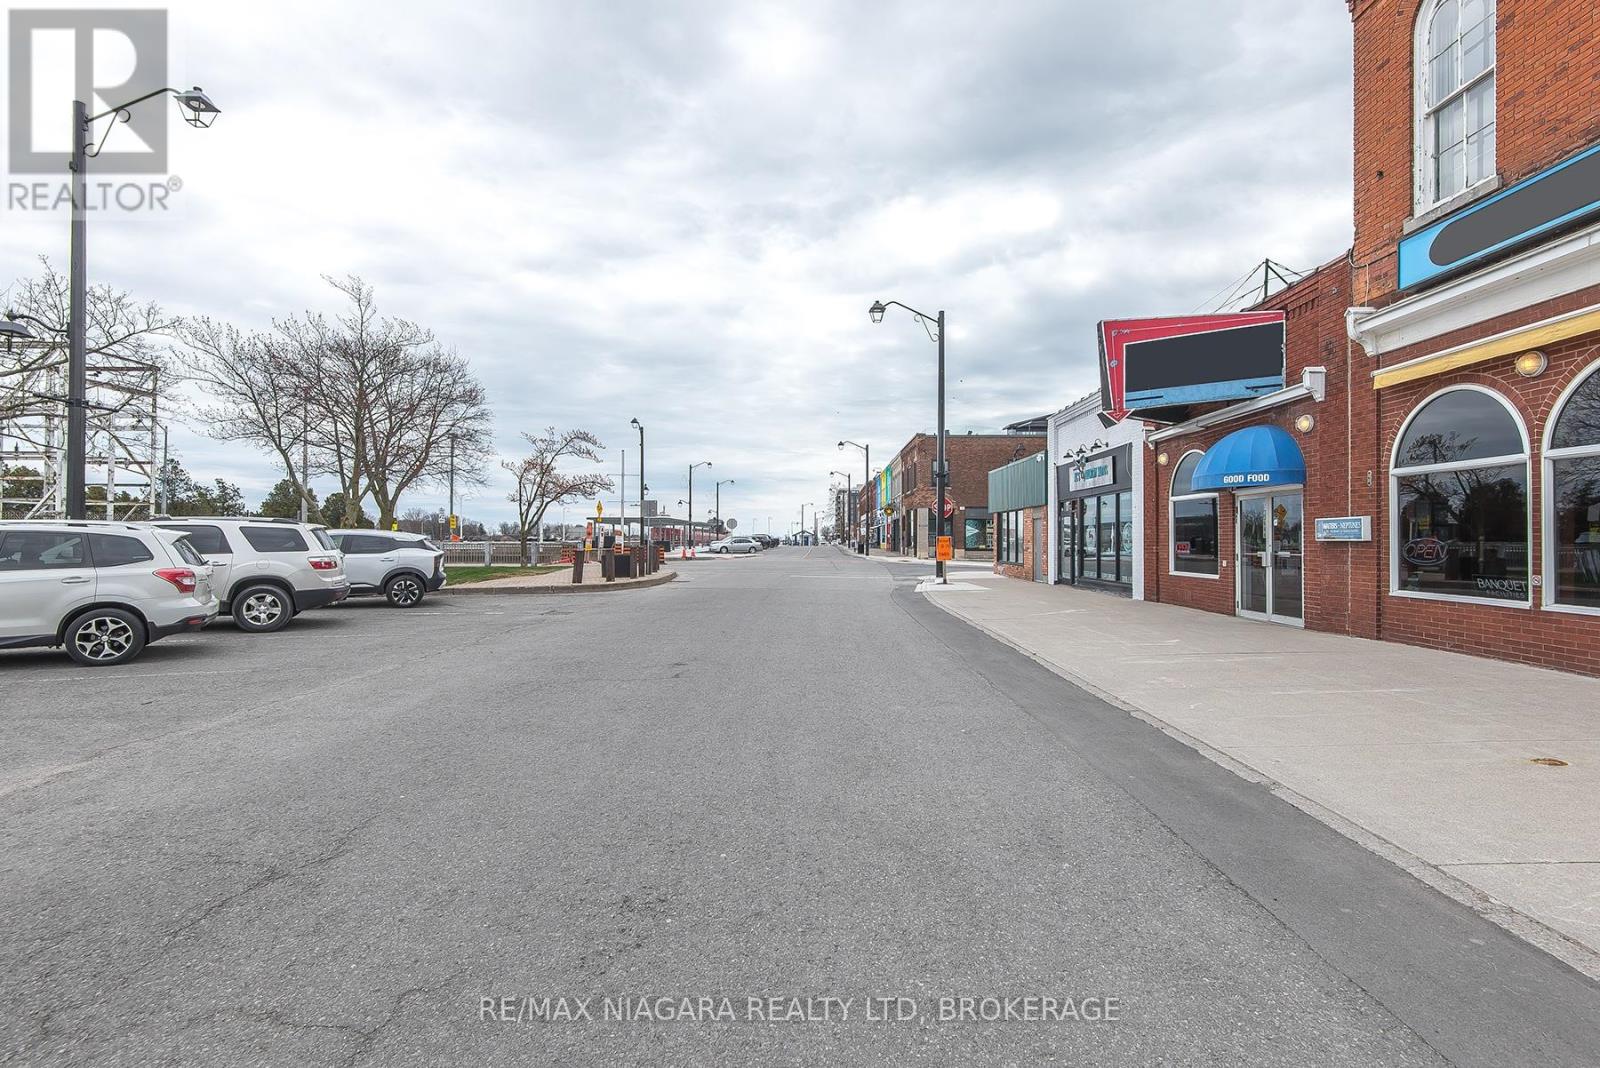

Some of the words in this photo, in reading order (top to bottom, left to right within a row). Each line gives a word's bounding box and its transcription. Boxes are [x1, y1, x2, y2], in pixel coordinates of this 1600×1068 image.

[1223, 475, 1244, 484] GOOD
[1247, 473, 1270, 483] FOOD
[933, 504, 951, 512] SP
[1405, 543, 1448, 559] OPEN
[1476, 578, 1527, 592] BANQUET
